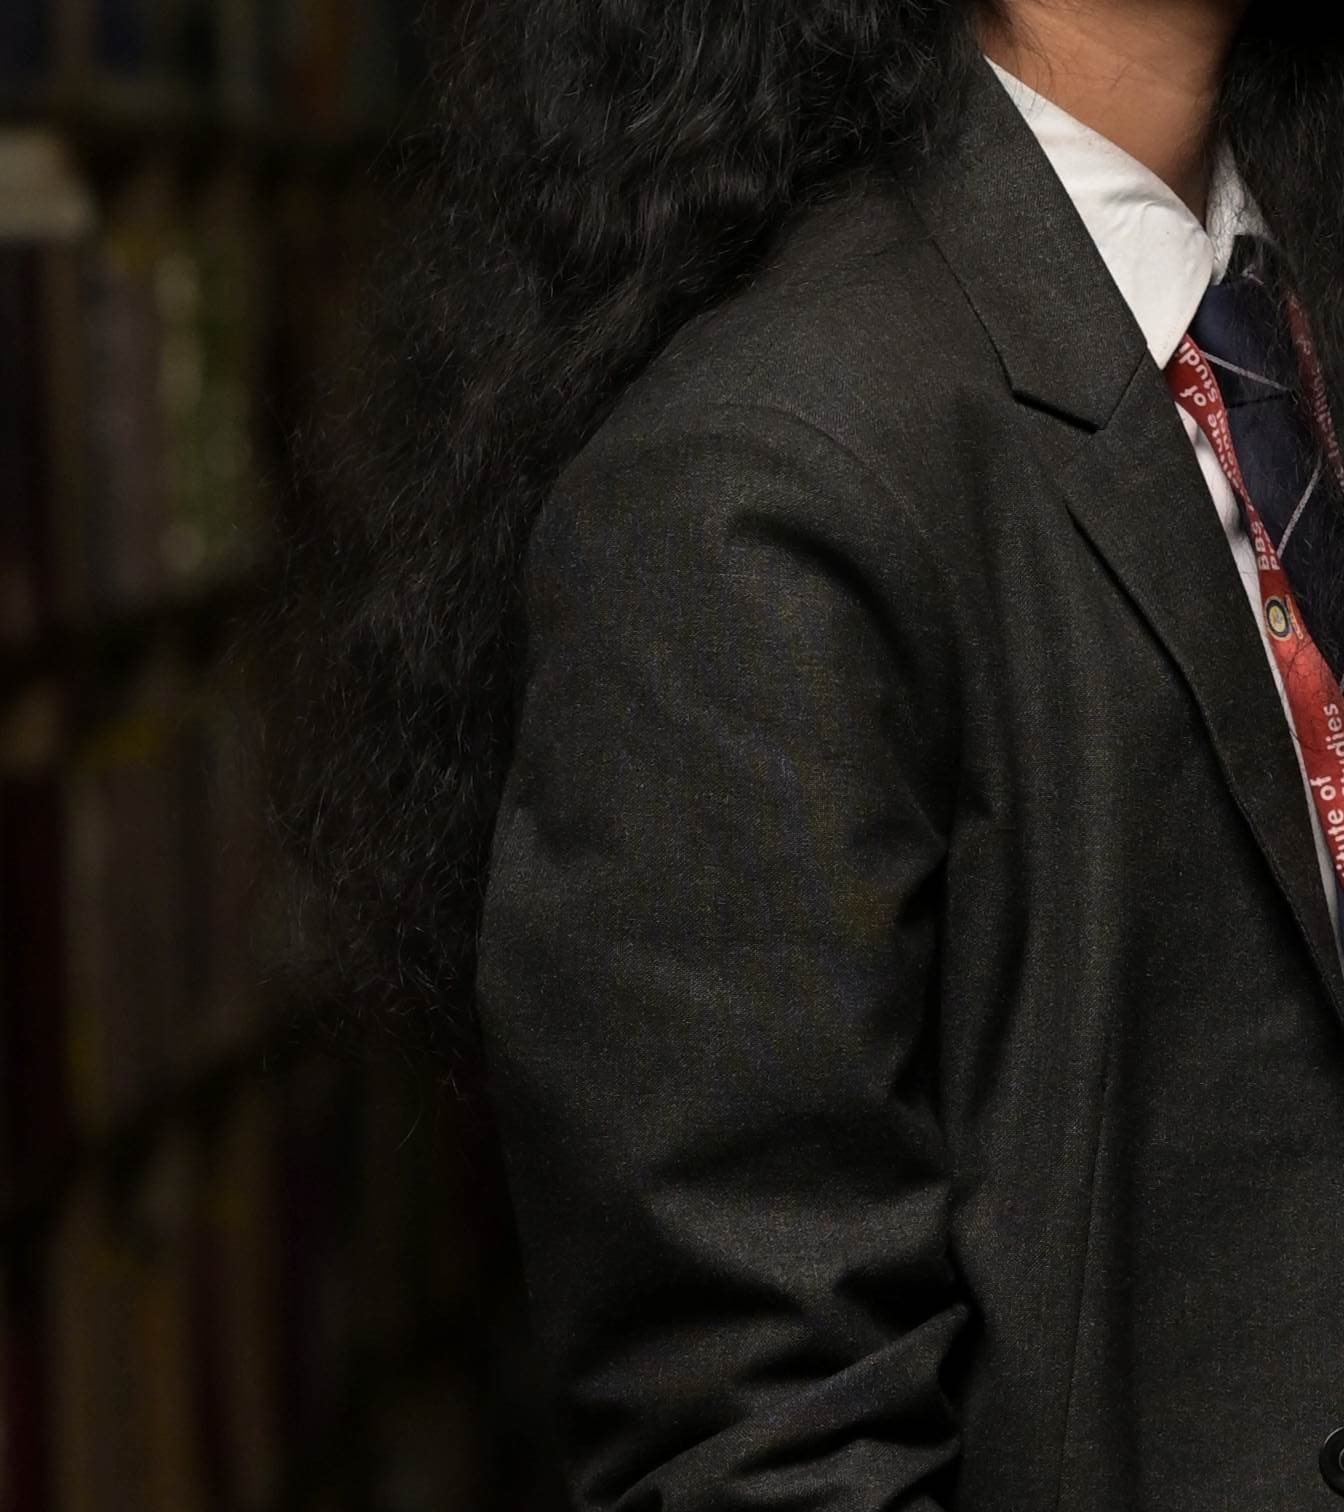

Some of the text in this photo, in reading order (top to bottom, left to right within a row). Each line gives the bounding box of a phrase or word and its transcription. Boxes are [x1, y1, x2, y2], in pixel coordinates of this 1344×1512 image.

[1177, 342, 1218, 403] Studi
[1179, 384, 1207, 408] of
[1251, 520, 1270, 571] BBS
[1310, 775, 1337, 801] of
